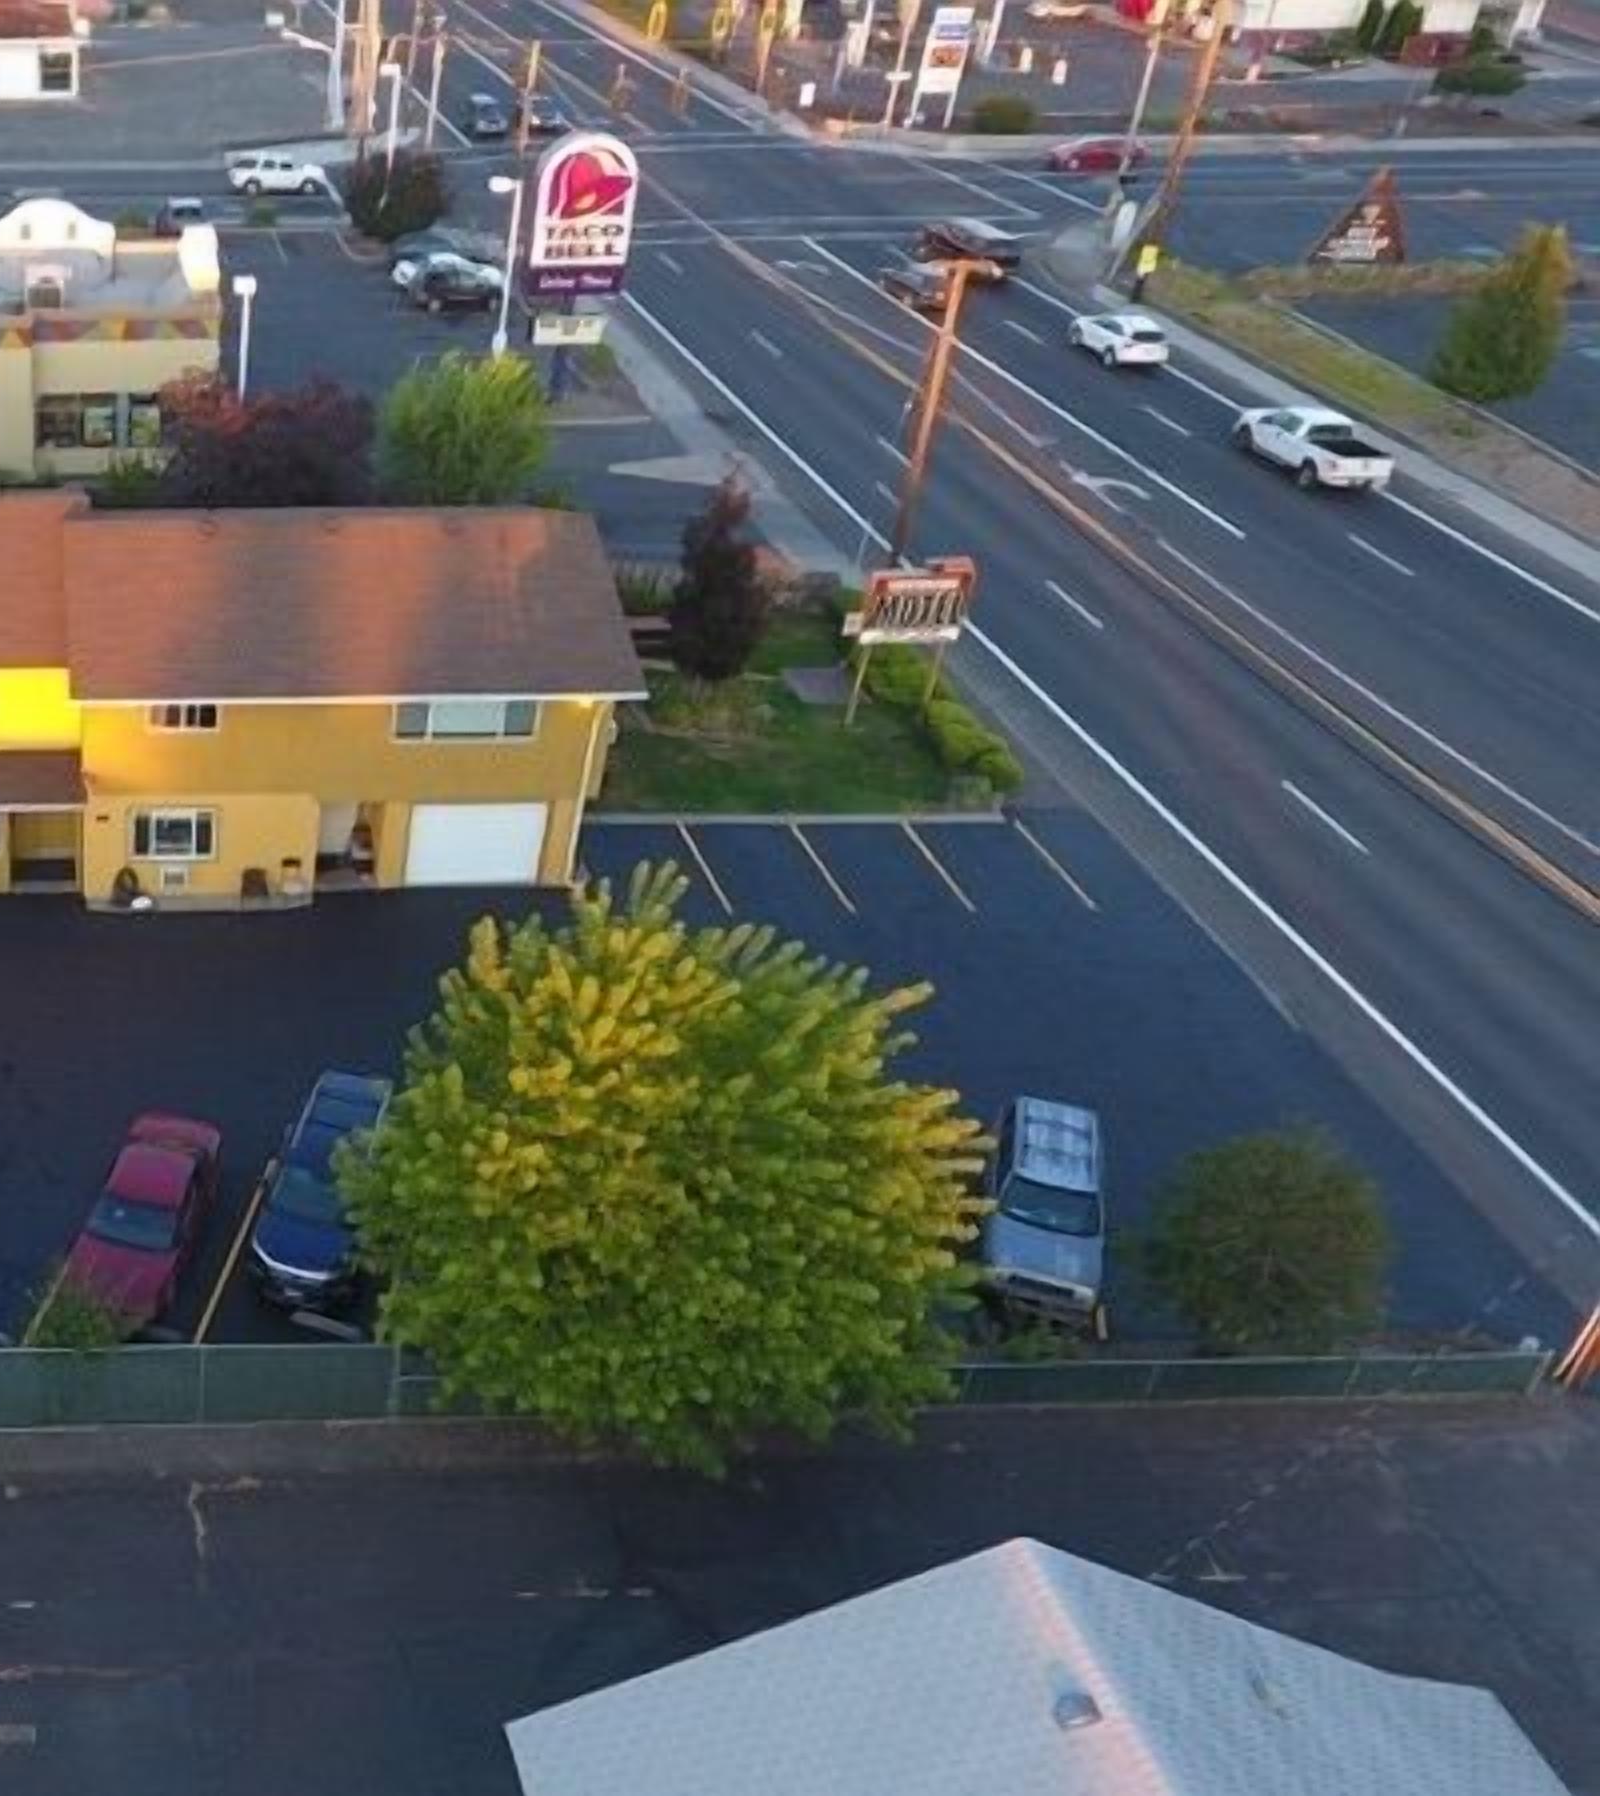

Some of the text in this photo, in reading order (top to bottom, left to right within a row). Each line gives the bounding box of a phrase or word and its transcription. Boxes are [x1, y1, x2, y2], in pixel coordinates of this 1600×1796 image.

[546, 224, 624, 242] TACO
[544, 242, 620, 260] BELL
[874, 592, 960, 628] MOTEL
